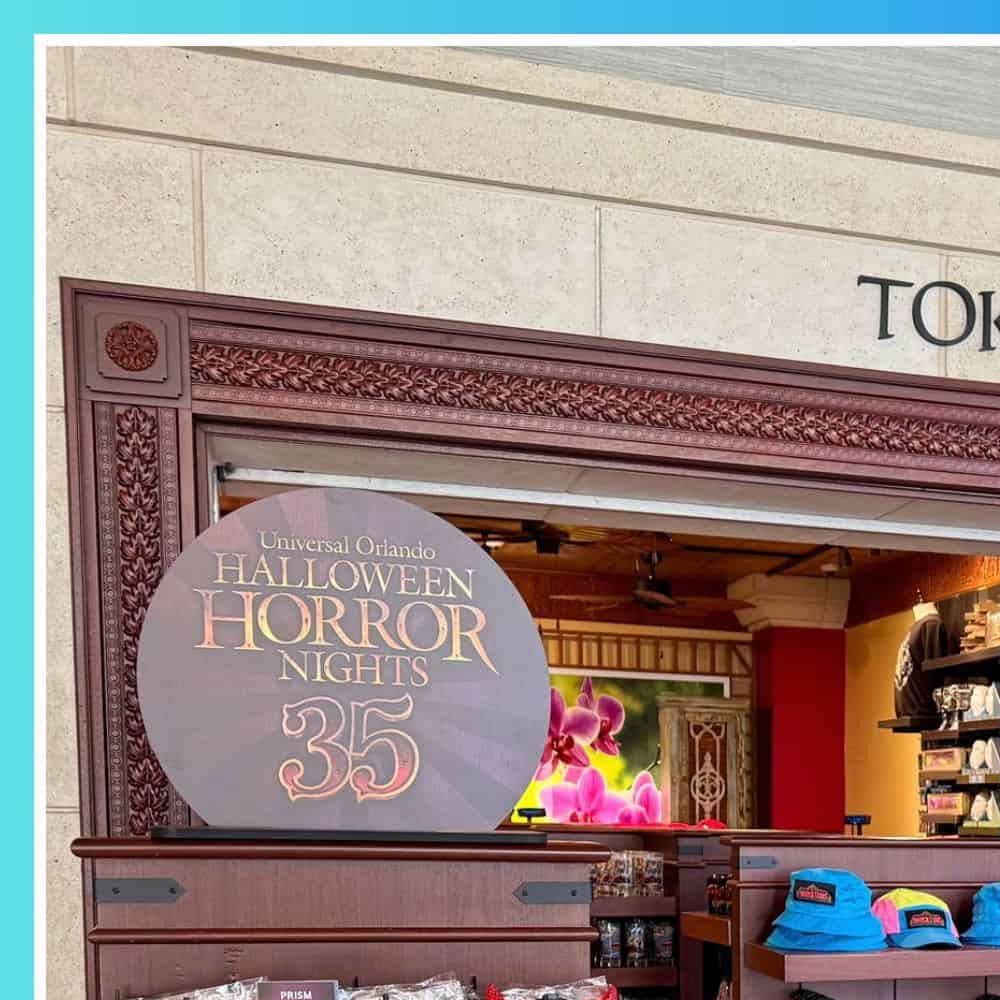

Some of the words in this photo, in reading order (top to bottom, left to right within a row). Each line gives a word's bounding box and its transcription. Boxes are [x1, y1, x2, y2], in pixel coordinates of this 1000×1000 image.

[259, 531, 350, 555] Universal
[356, 536, 436, 560] Orlando
[214, 552, 478, 599] HALLOWEEN
[193, 588, 499, 674] HORROR
[278, 649, 430, 688] NIGHTS
[278, 694, 420, 802] 35
[280, 991, 313, 1000] PRISM
